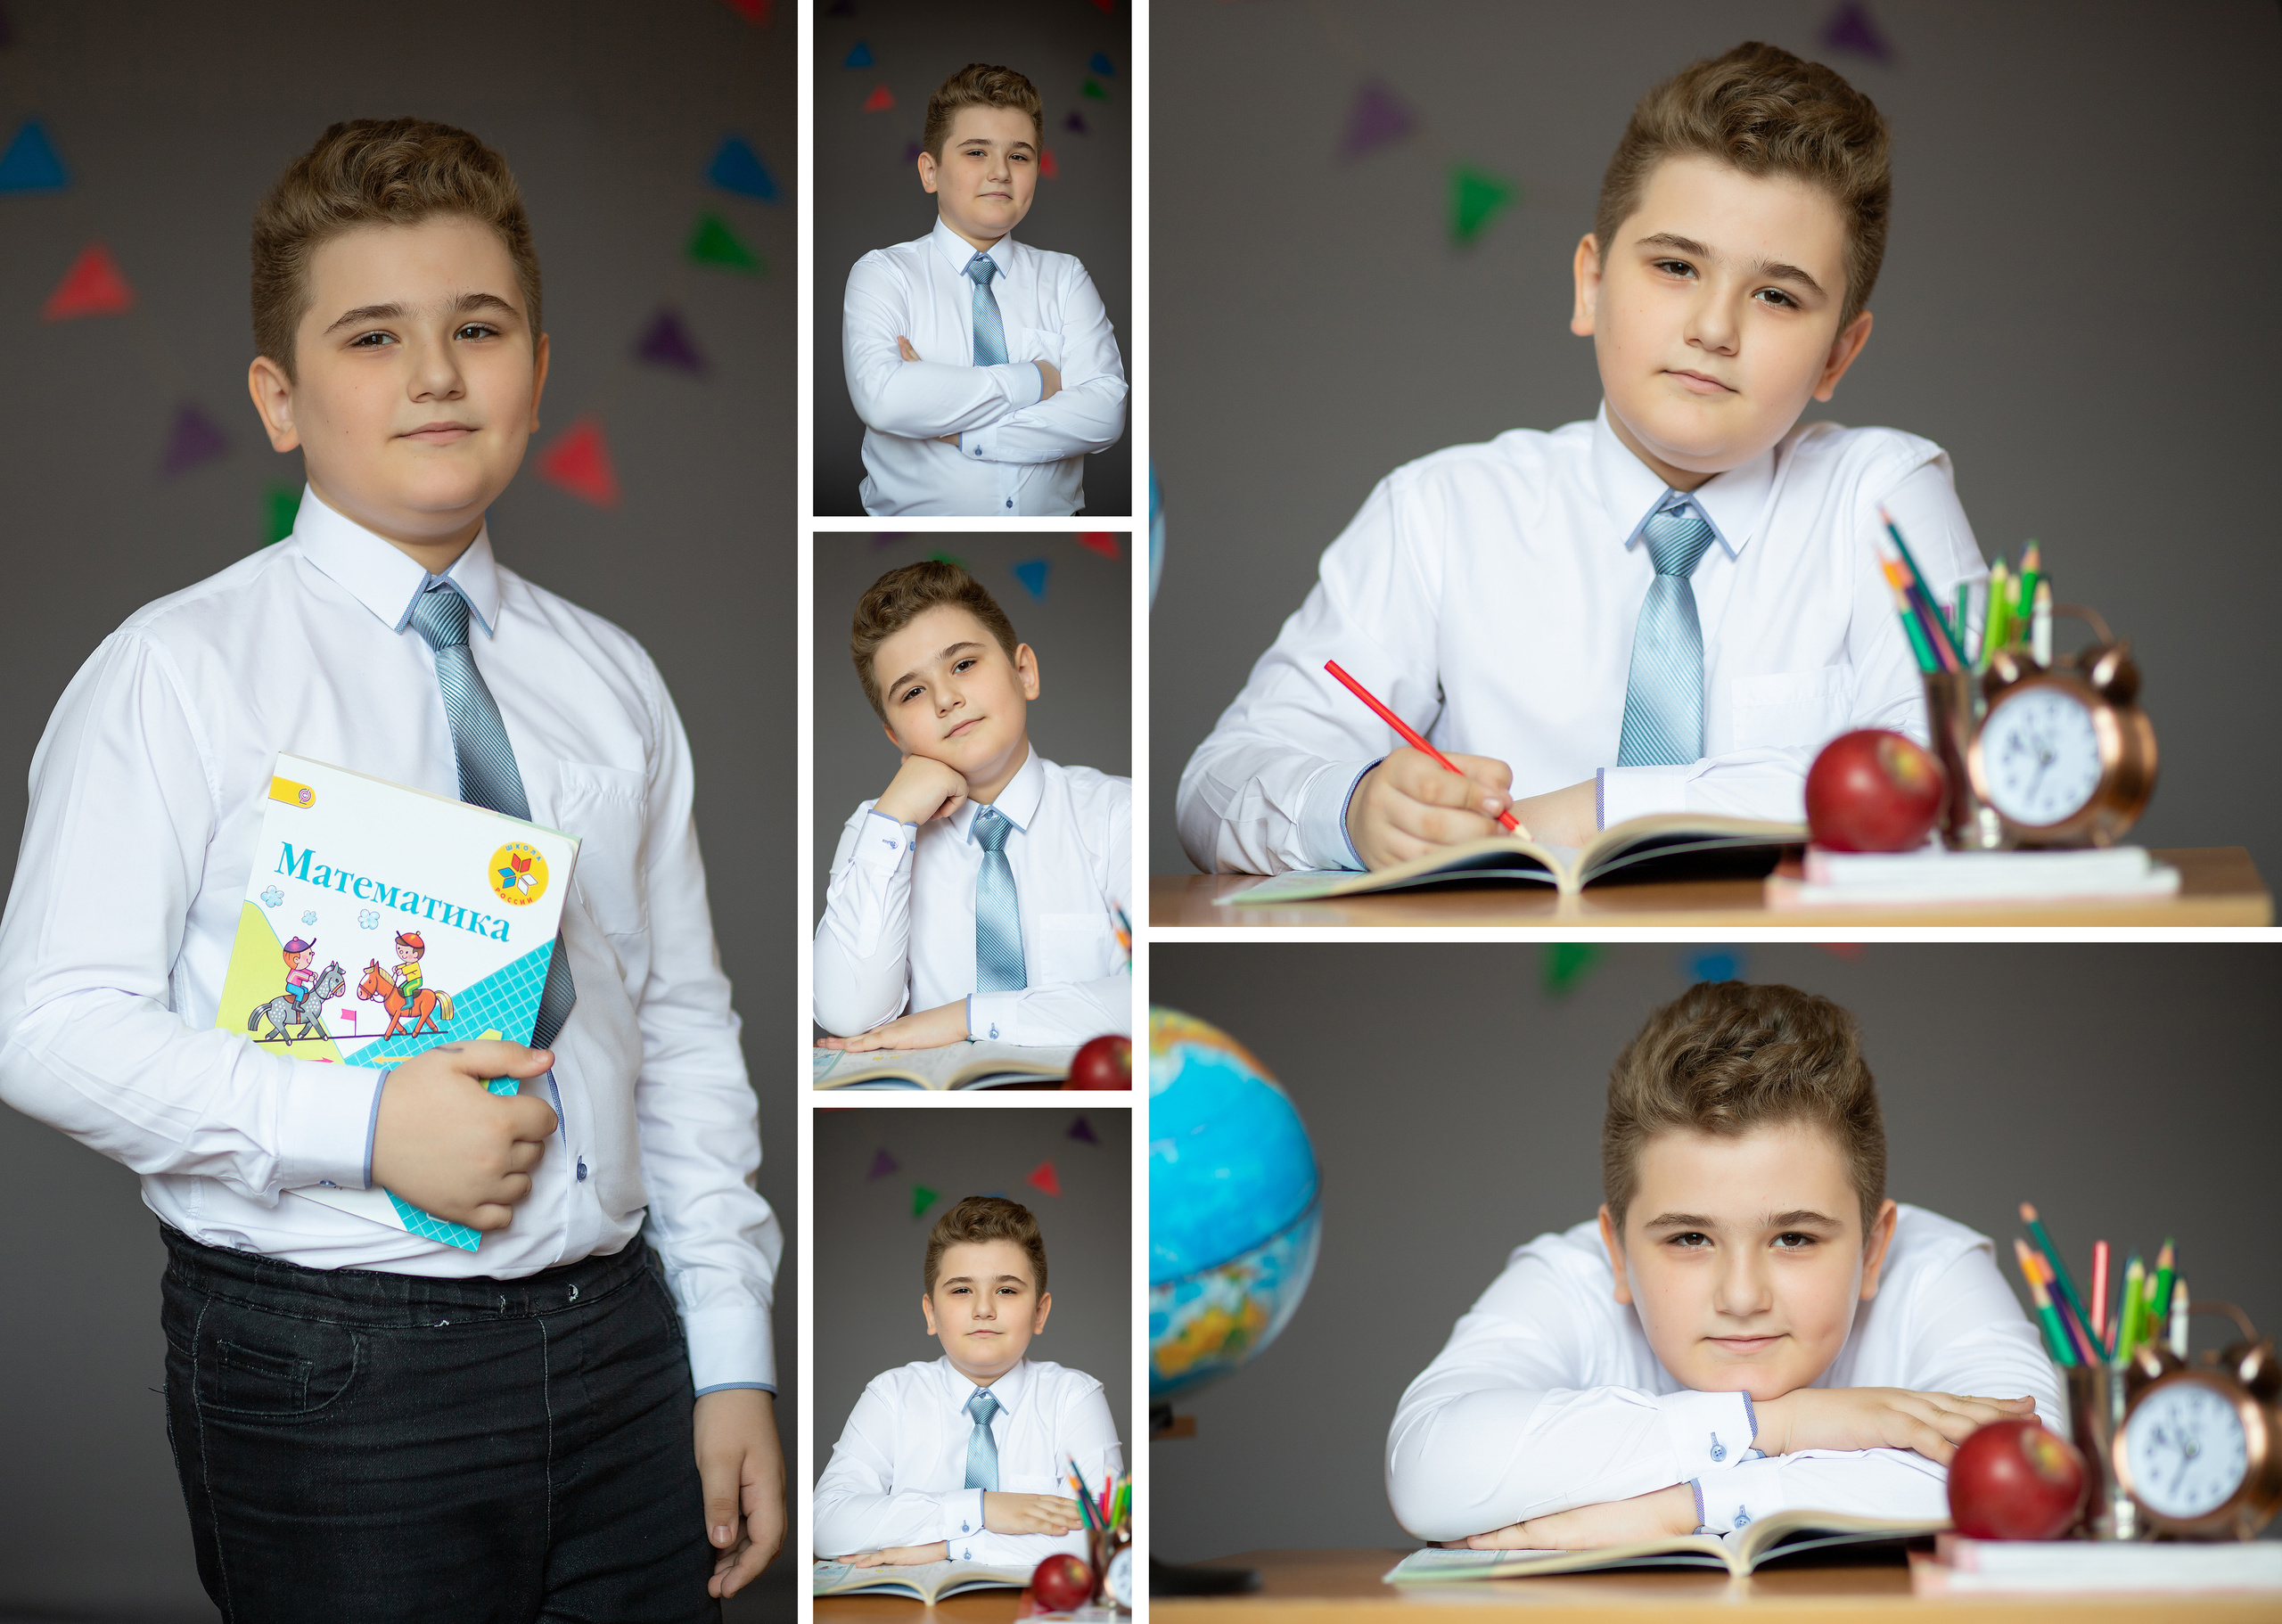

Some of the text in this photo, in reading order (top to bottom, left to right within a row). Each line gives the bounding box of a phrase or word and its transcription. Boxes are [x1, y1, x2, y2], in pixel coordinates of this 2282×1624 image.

[505, 843, 541, 862] ШКОЛА
[275, 841, 510, 942] Математика
[495, 887, 533, 906] РОССИИ
